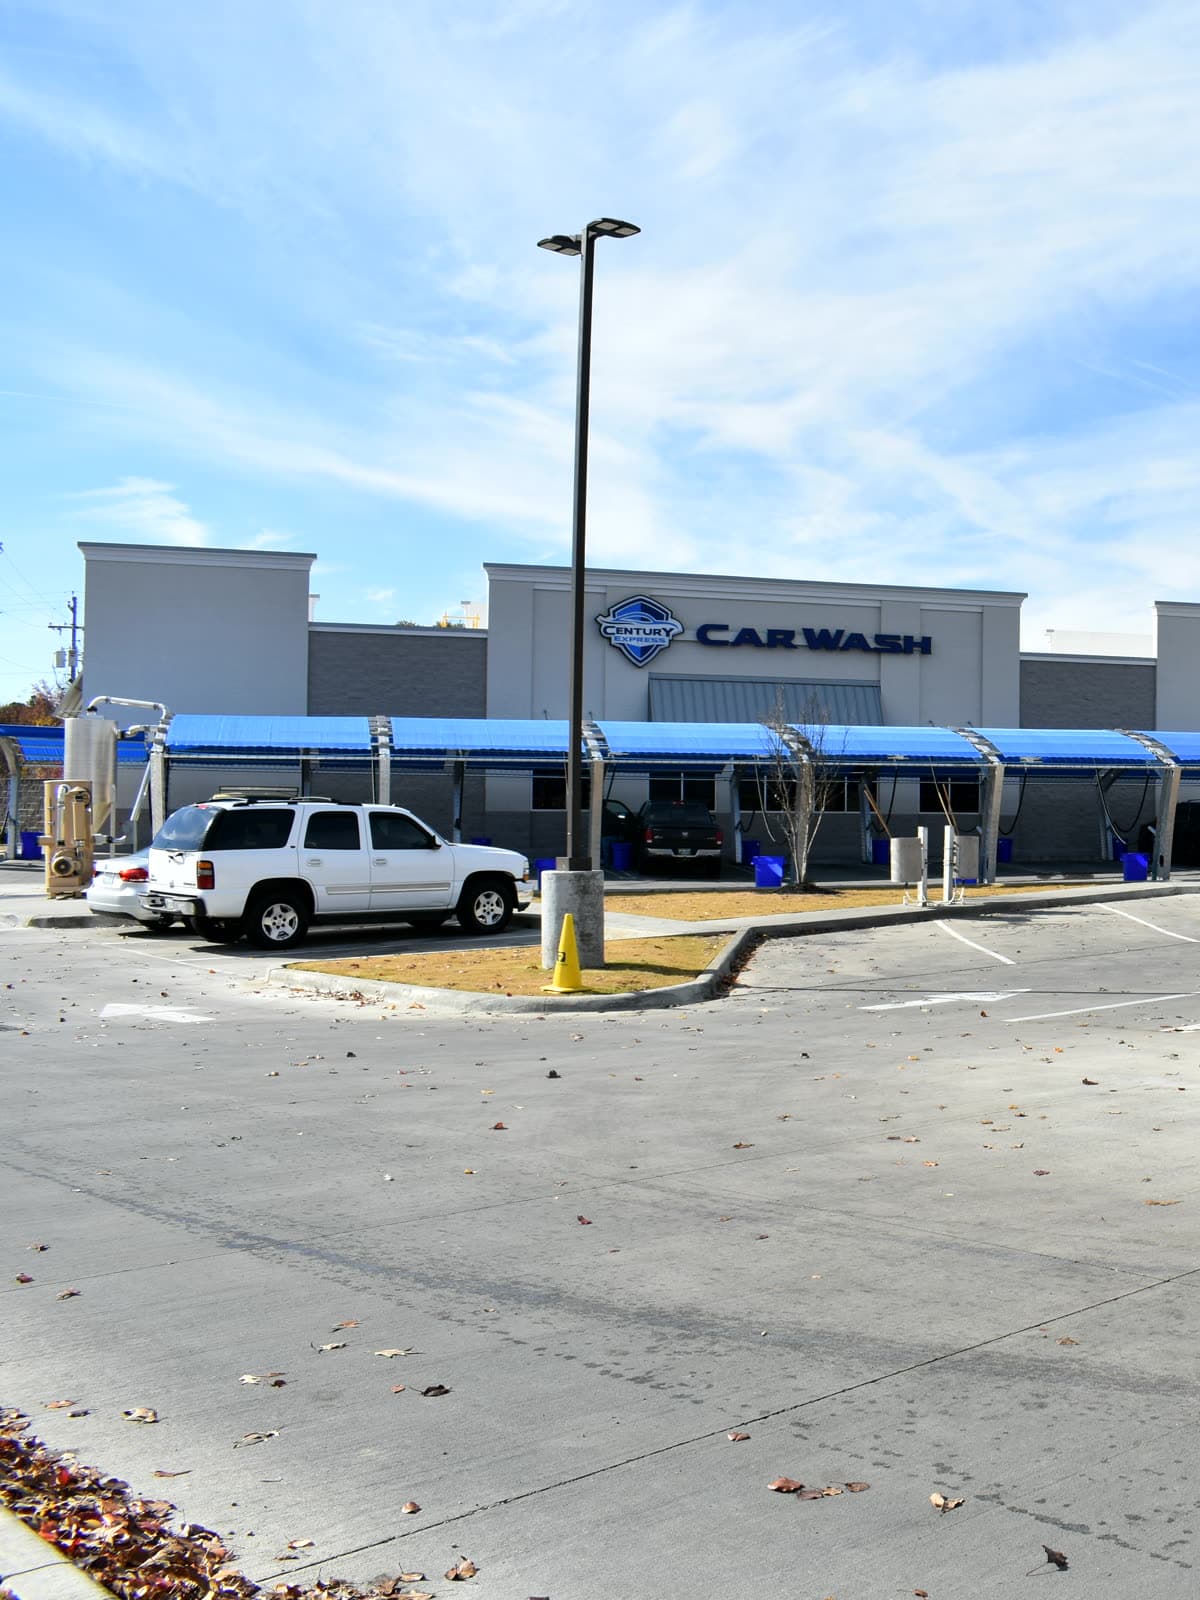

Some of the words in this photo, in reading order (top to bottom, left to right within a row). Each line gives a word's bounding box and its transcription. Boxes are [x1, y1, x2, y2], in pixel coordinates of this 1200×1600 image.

[603, 625, 675, 638] CENTURY
[696, 623, 798, 649] CAR
[802, 627, 932, 655] WASH
